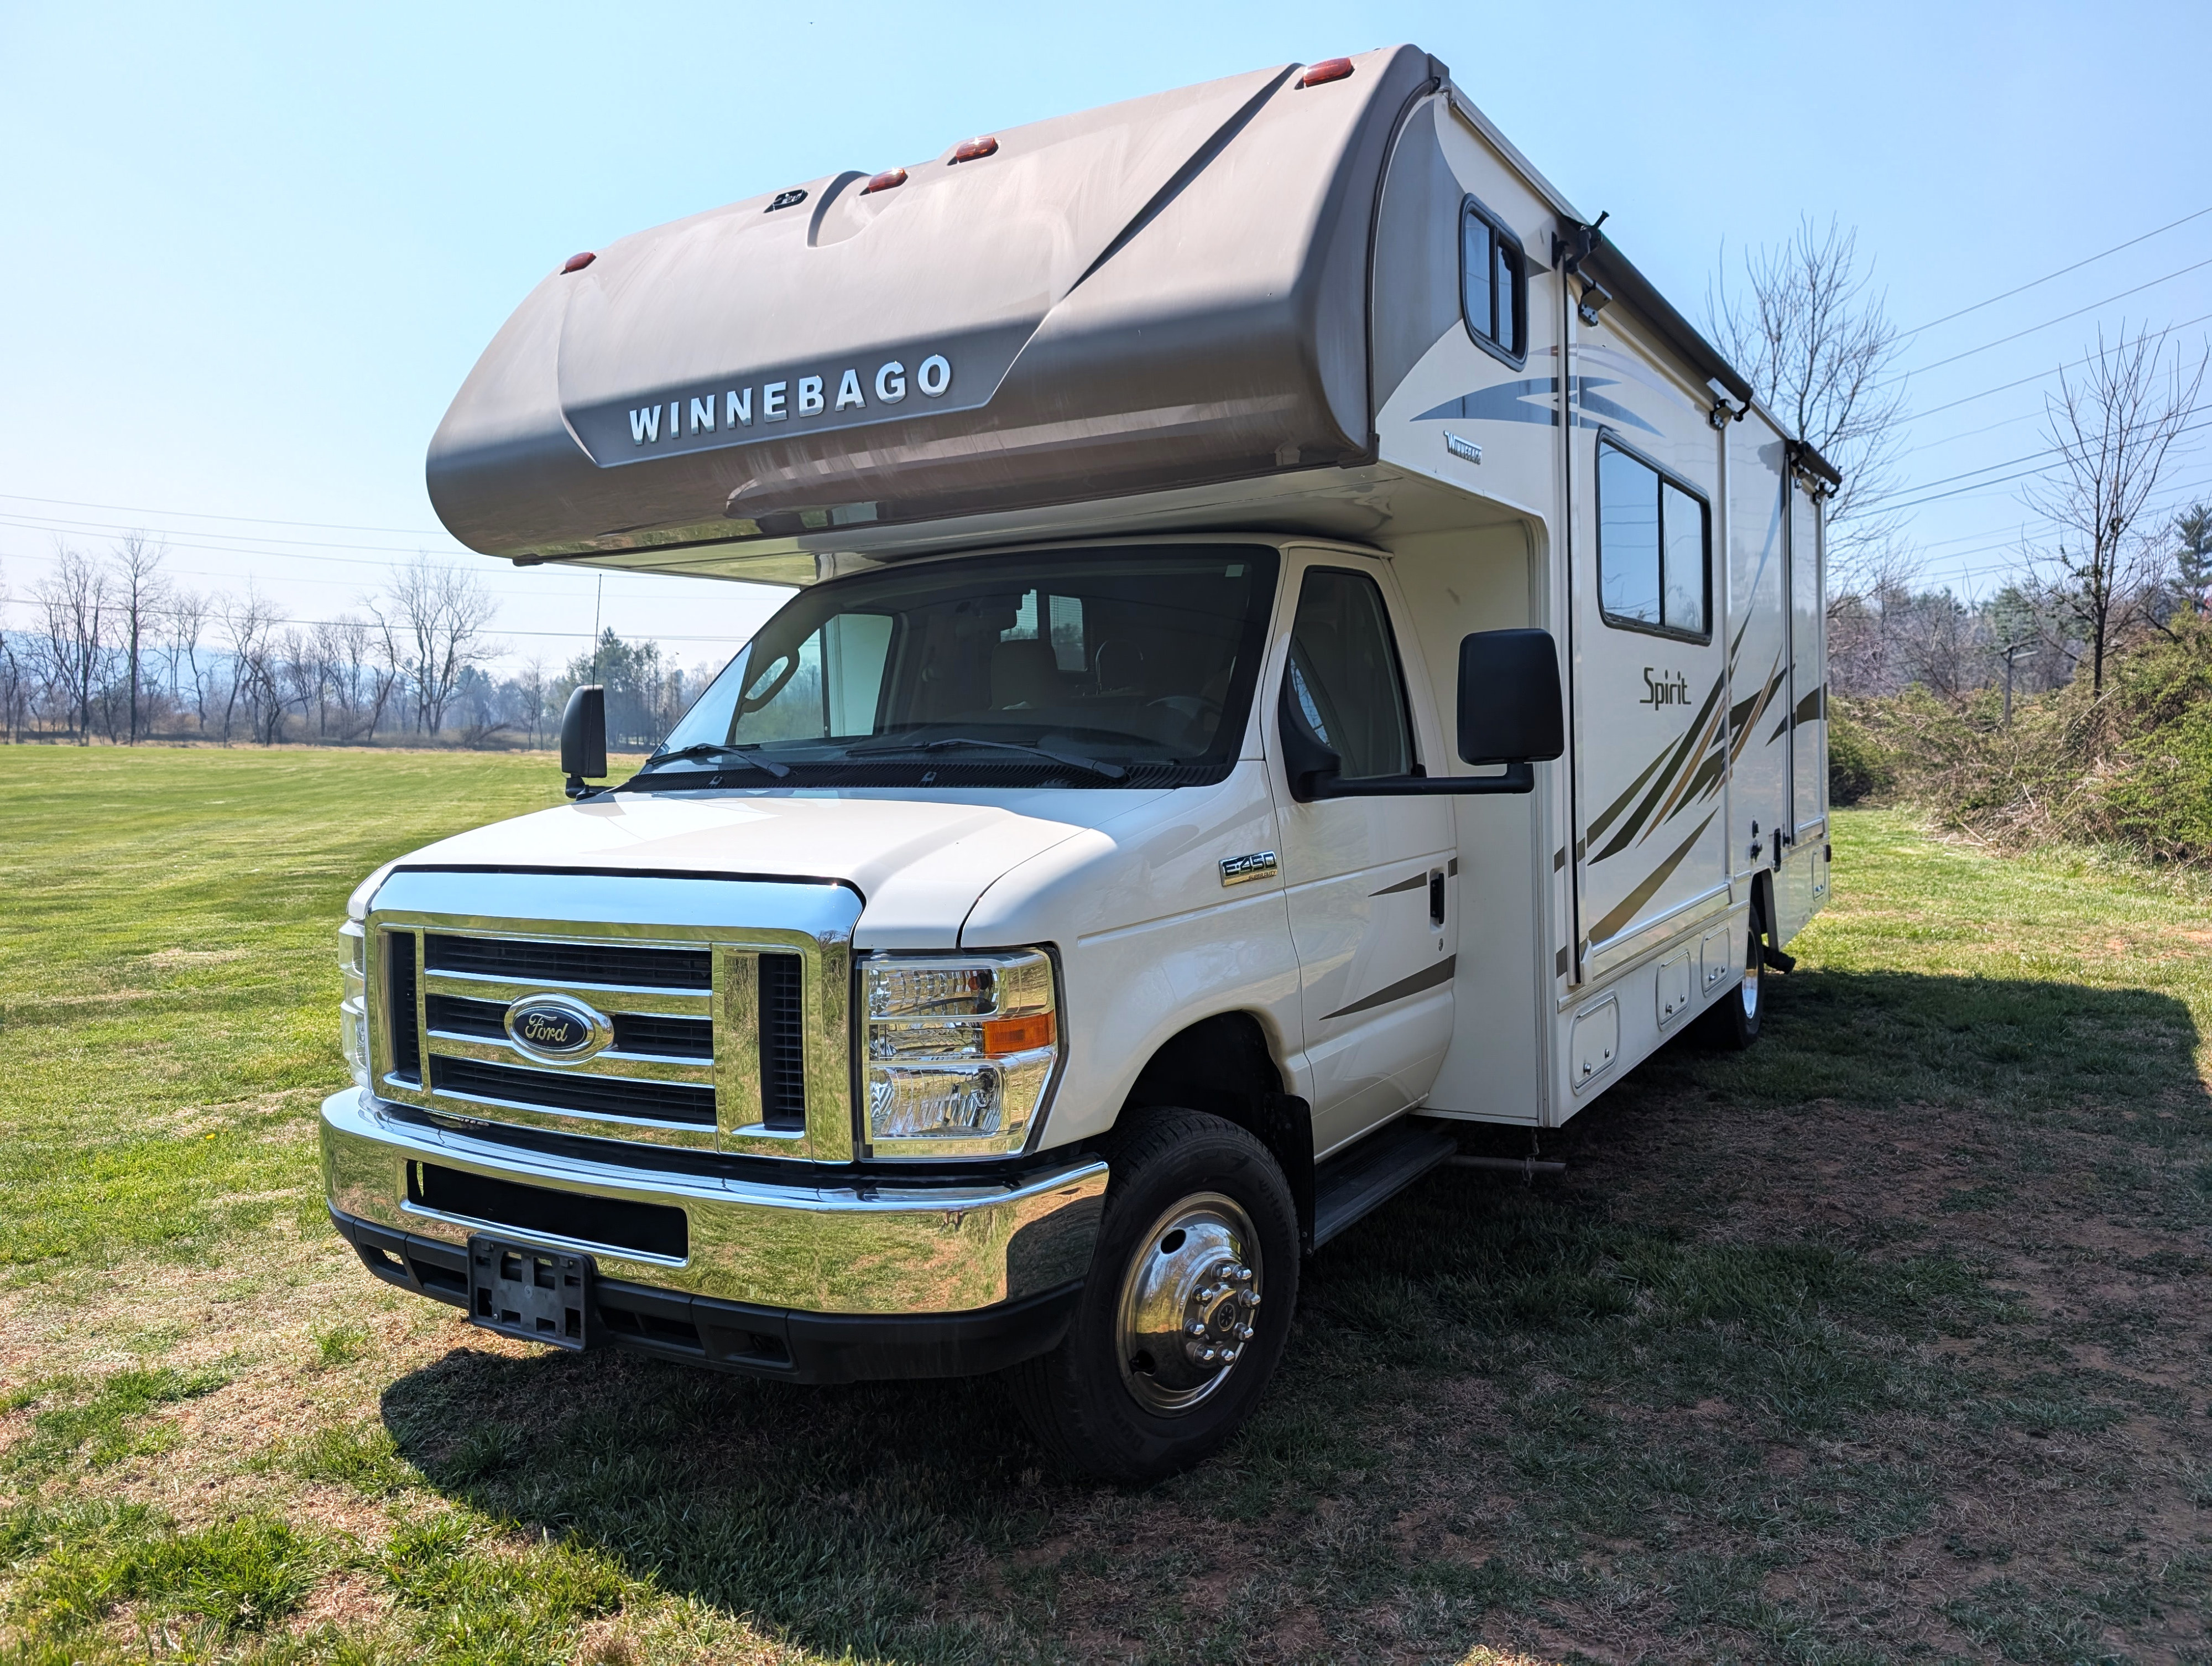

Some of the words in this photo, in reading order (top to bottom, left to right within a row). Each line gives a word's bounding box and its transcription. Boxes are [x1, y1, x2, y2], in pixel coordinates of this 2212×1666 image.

[629, 355, 951, 446] WINNEBAGO
[1640, 667, 1692, 711] Spirit
[1223, 853, 1276, 876] E-450
[525, 1014, 568, 1042] Ford
